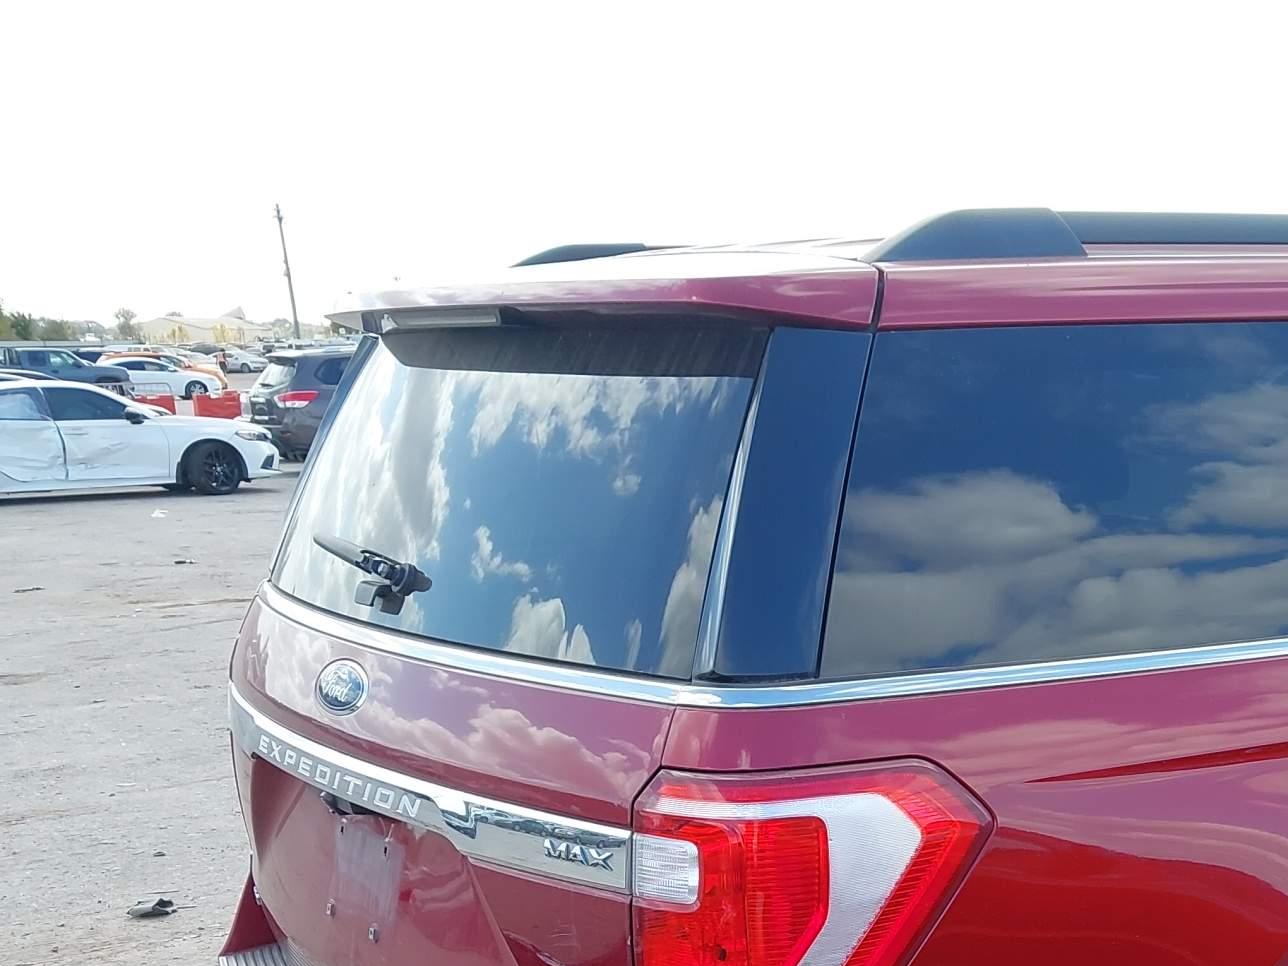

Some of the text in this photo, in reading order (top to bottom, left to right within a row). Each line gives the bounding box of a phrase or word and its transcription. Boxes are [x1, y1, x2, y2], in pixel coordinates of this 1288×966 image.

[320, 667, 353, 703] Ford
[258, 734, 422, 818] EXPEDITION
[543, 838, 614, 872] MAX
